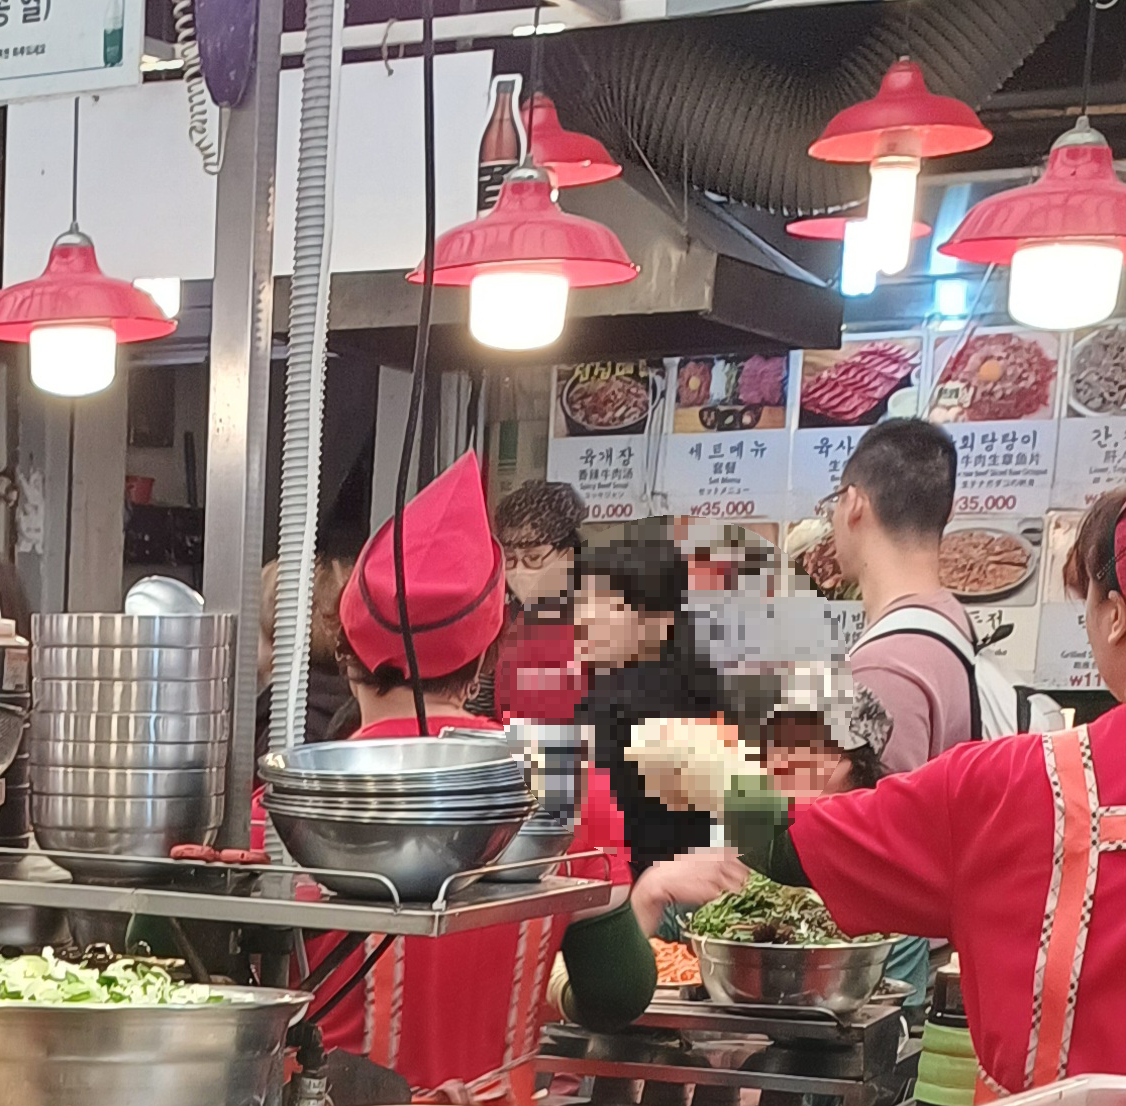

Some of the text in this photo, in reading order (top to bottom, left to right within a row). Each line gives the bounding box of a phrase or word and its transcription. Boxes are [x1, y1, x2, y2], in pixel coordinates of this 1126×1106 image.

[1091, 425, 1126, 448] 간.
[579, 446, 635, 468] 육개장
[689, 440, 767, 461] 세트메뉴
